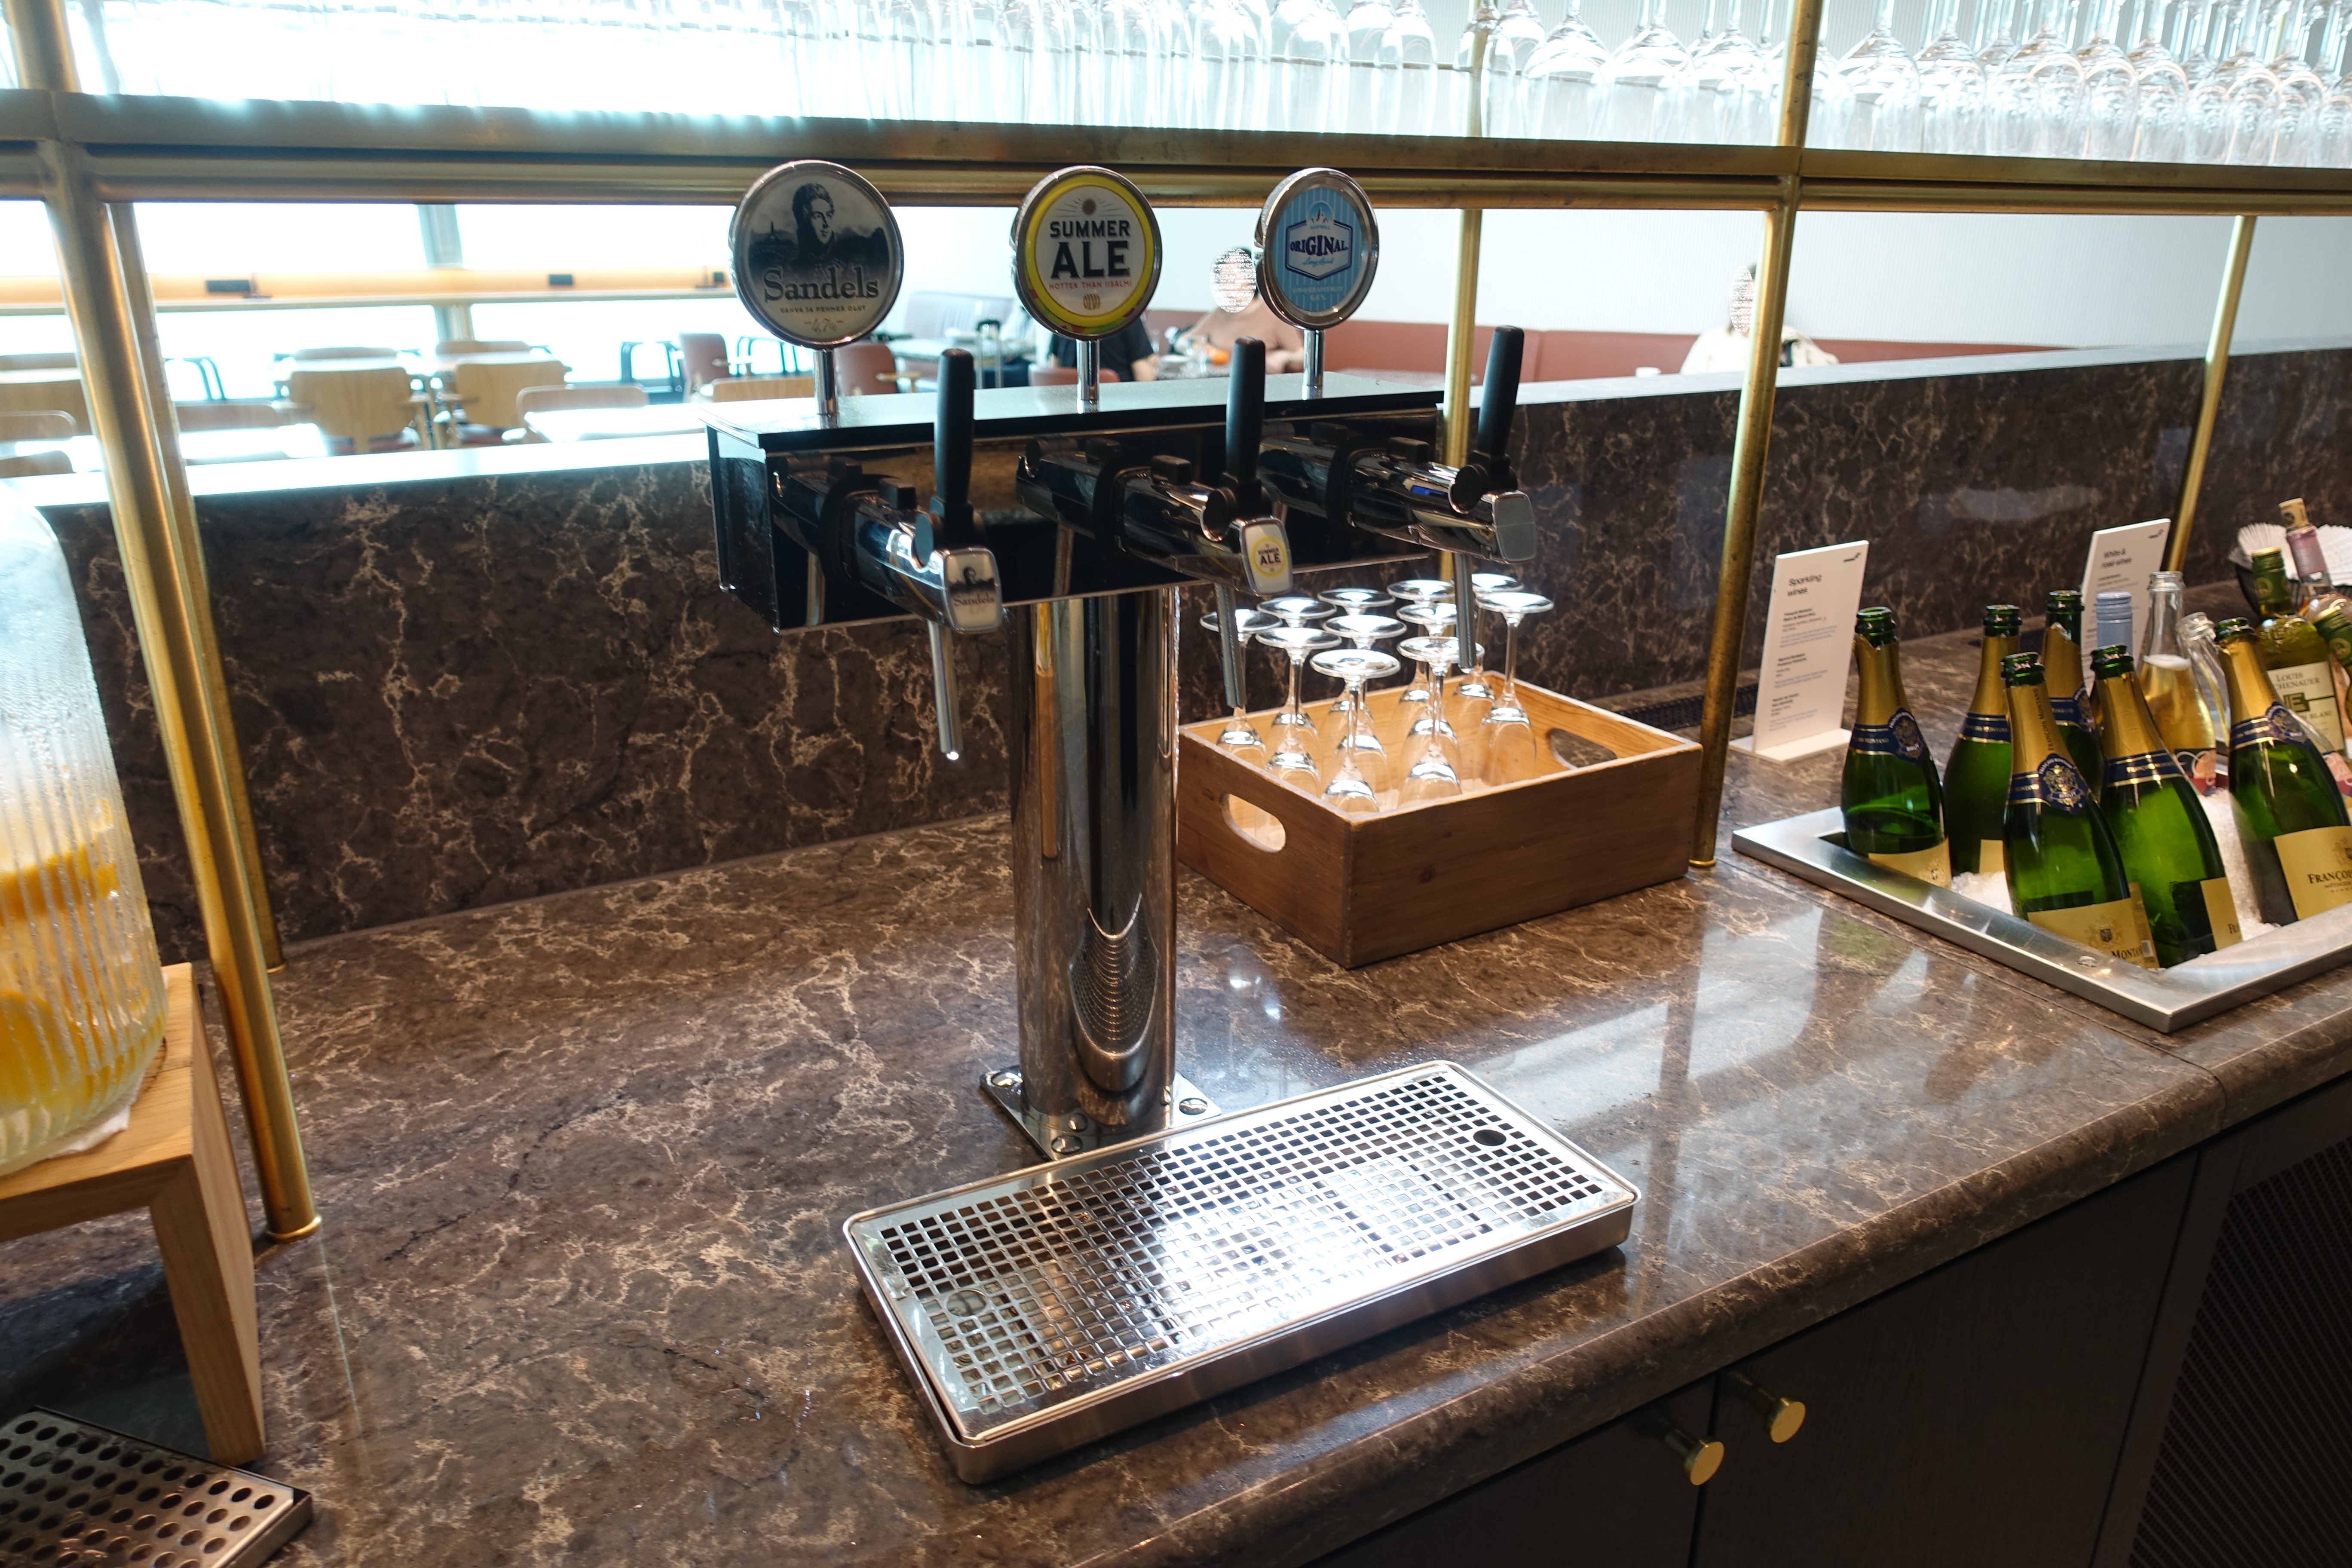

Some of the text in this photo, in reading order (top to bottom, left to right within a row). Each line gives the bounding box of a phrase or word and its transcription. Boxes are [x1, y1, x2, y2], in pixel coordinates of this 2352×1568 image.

[1050, 220, 1130, 238] SUMMER
[1050, 240, 1131, 279] ALE
[763, 264, 879, 302] Sandels
[1260, 554, 1281, 565] ALE
[953, 592, 995, 606] Sandels
[2275, 672, 2303, 682] LOUIS
